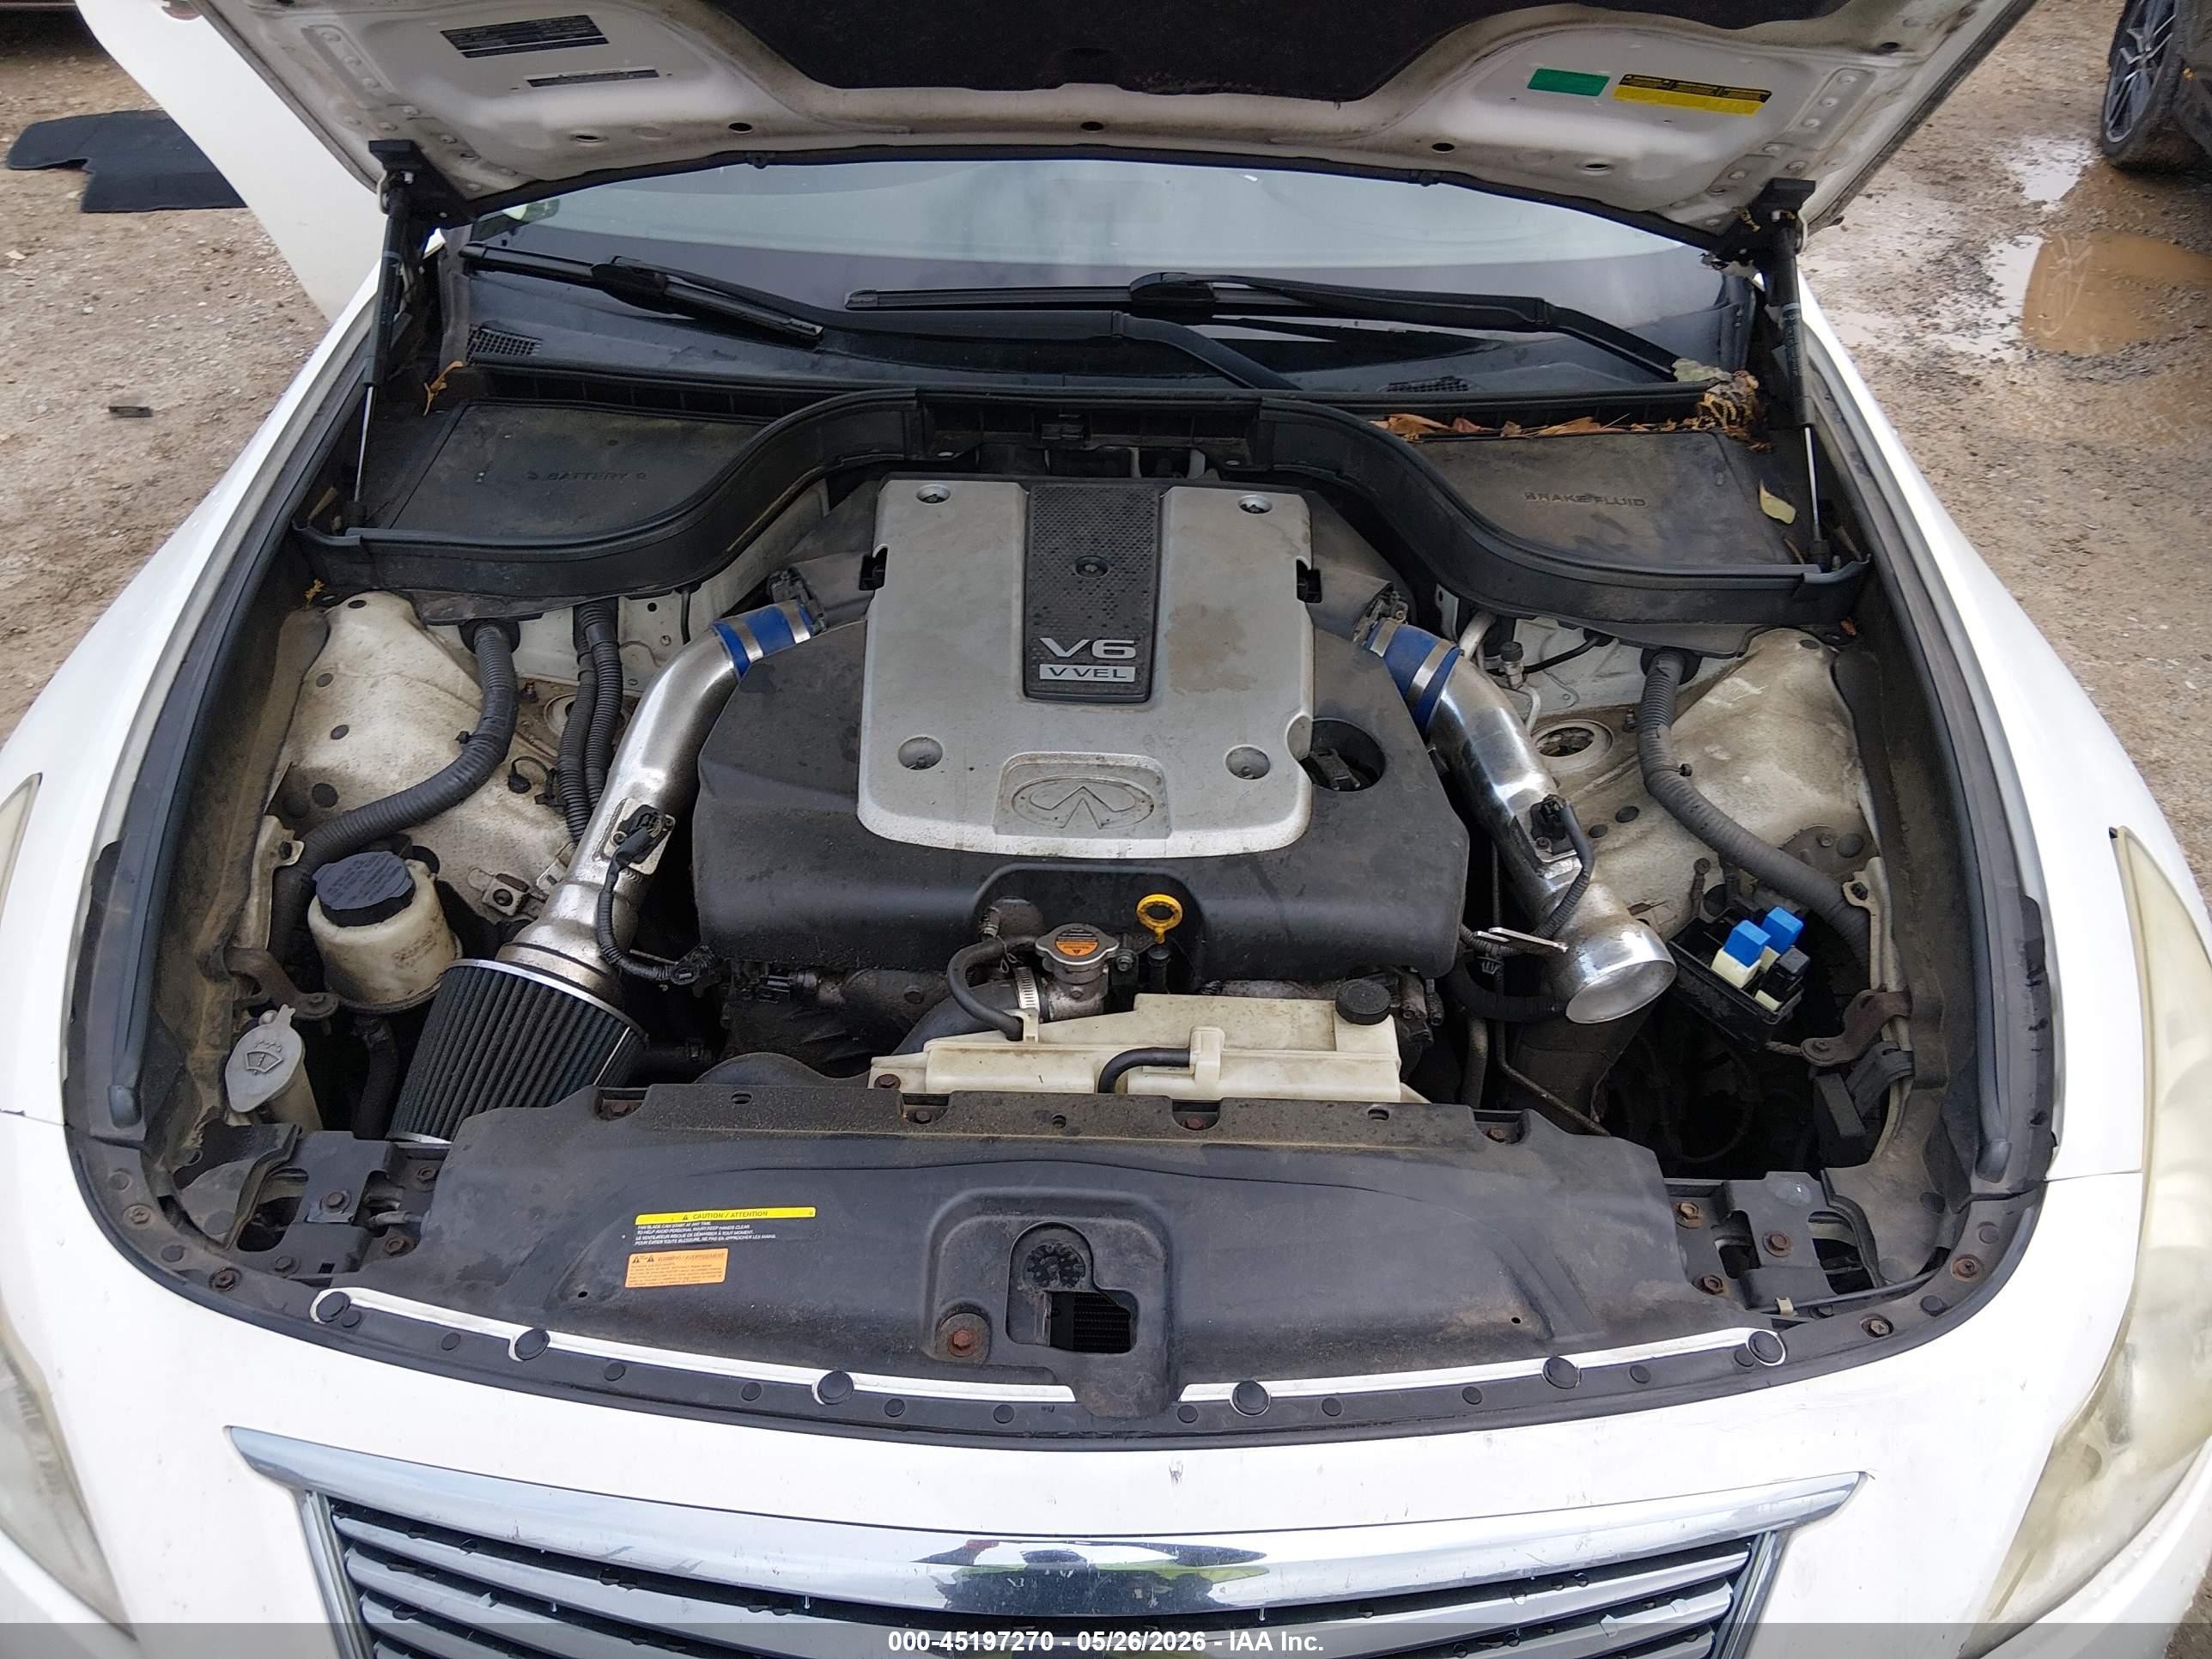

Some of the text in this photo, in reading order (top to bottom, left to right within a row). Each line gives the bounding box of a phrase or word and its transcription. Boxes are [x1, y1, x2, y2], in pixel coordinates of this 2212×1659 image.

[1523, 491, 1647, 507] BRAKE FLUID
[1039, 637, 1137, 659] V6
[1048, 667, 1127, 678] VVEL
